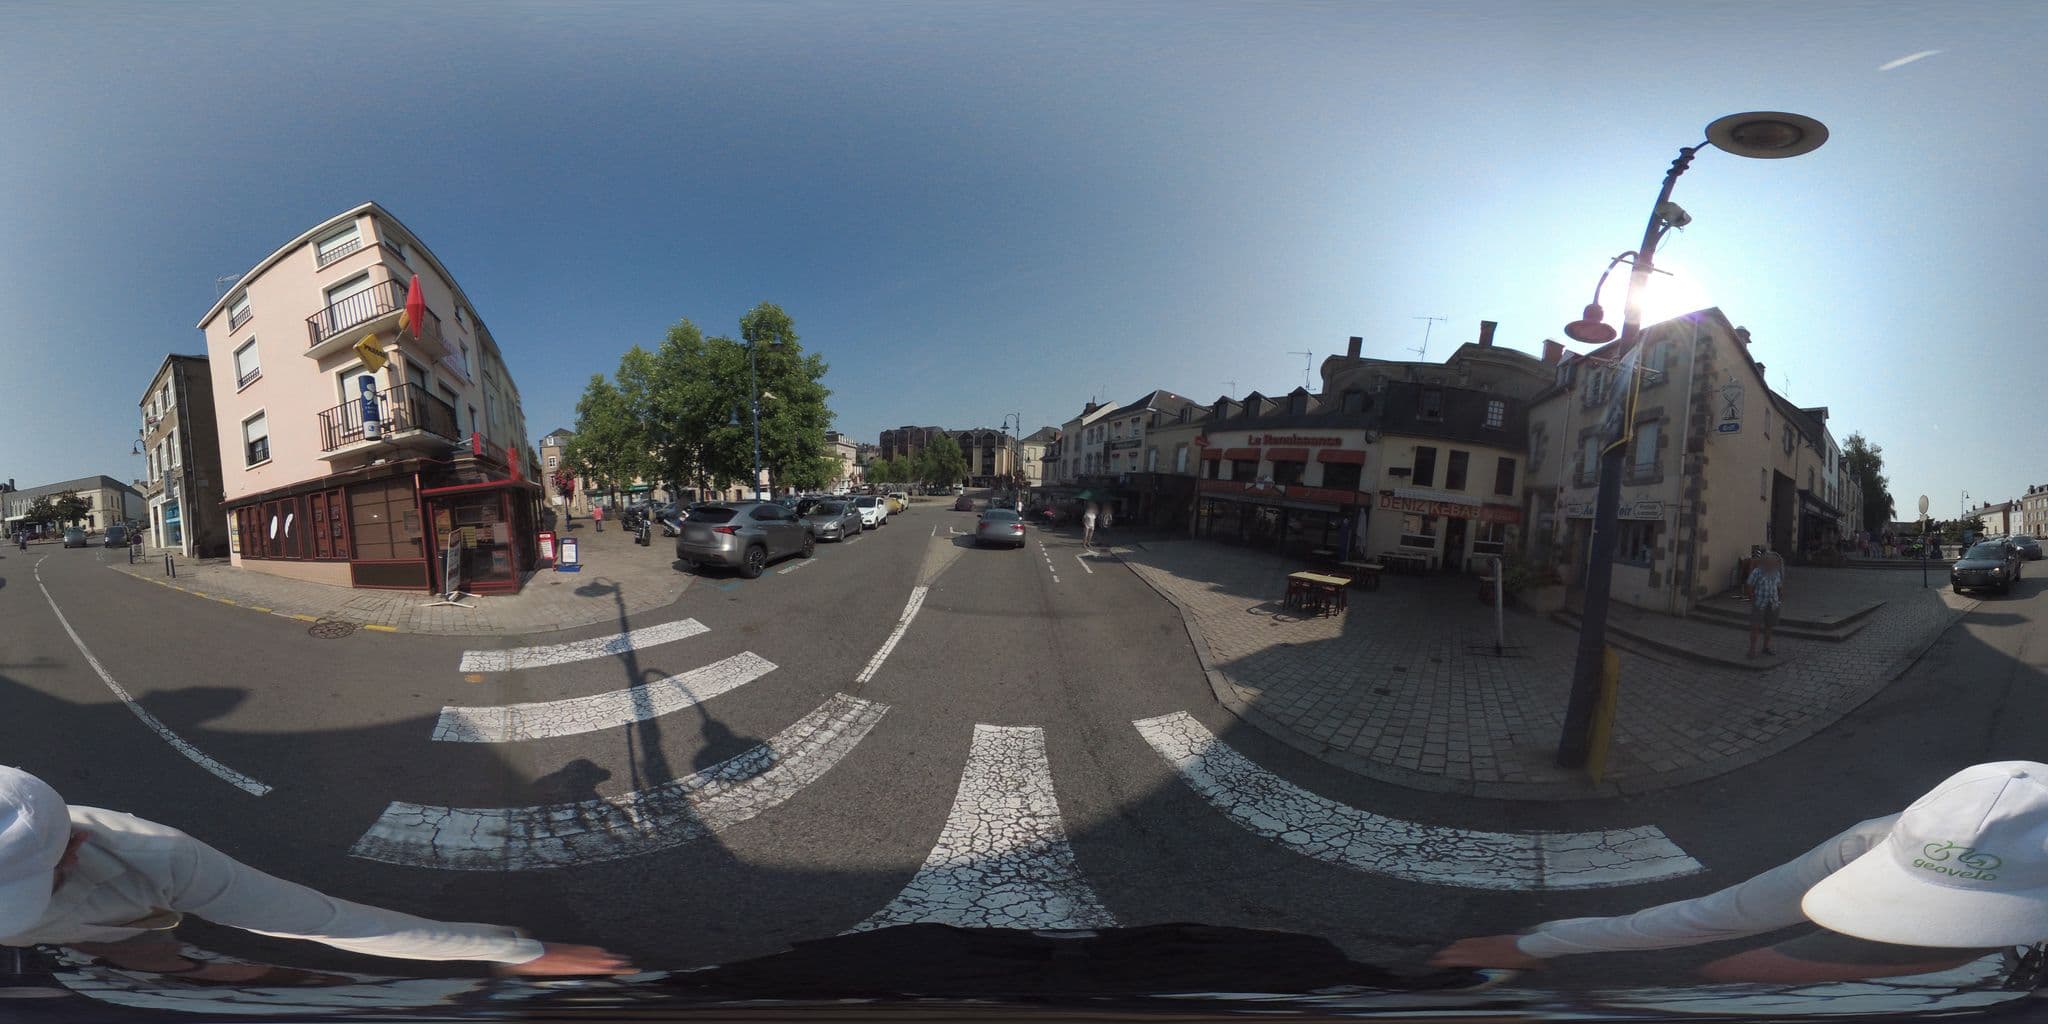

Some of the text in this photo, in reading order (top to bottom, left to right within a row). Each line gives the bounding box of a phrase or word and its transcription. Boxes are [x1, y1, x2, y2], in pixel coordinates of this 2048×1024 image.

[1380, 496, 1425, 512] DENIZ
[1429, 502, 1481, 518] KEBAB
[1912, 857, 1998, 882] geovelo
